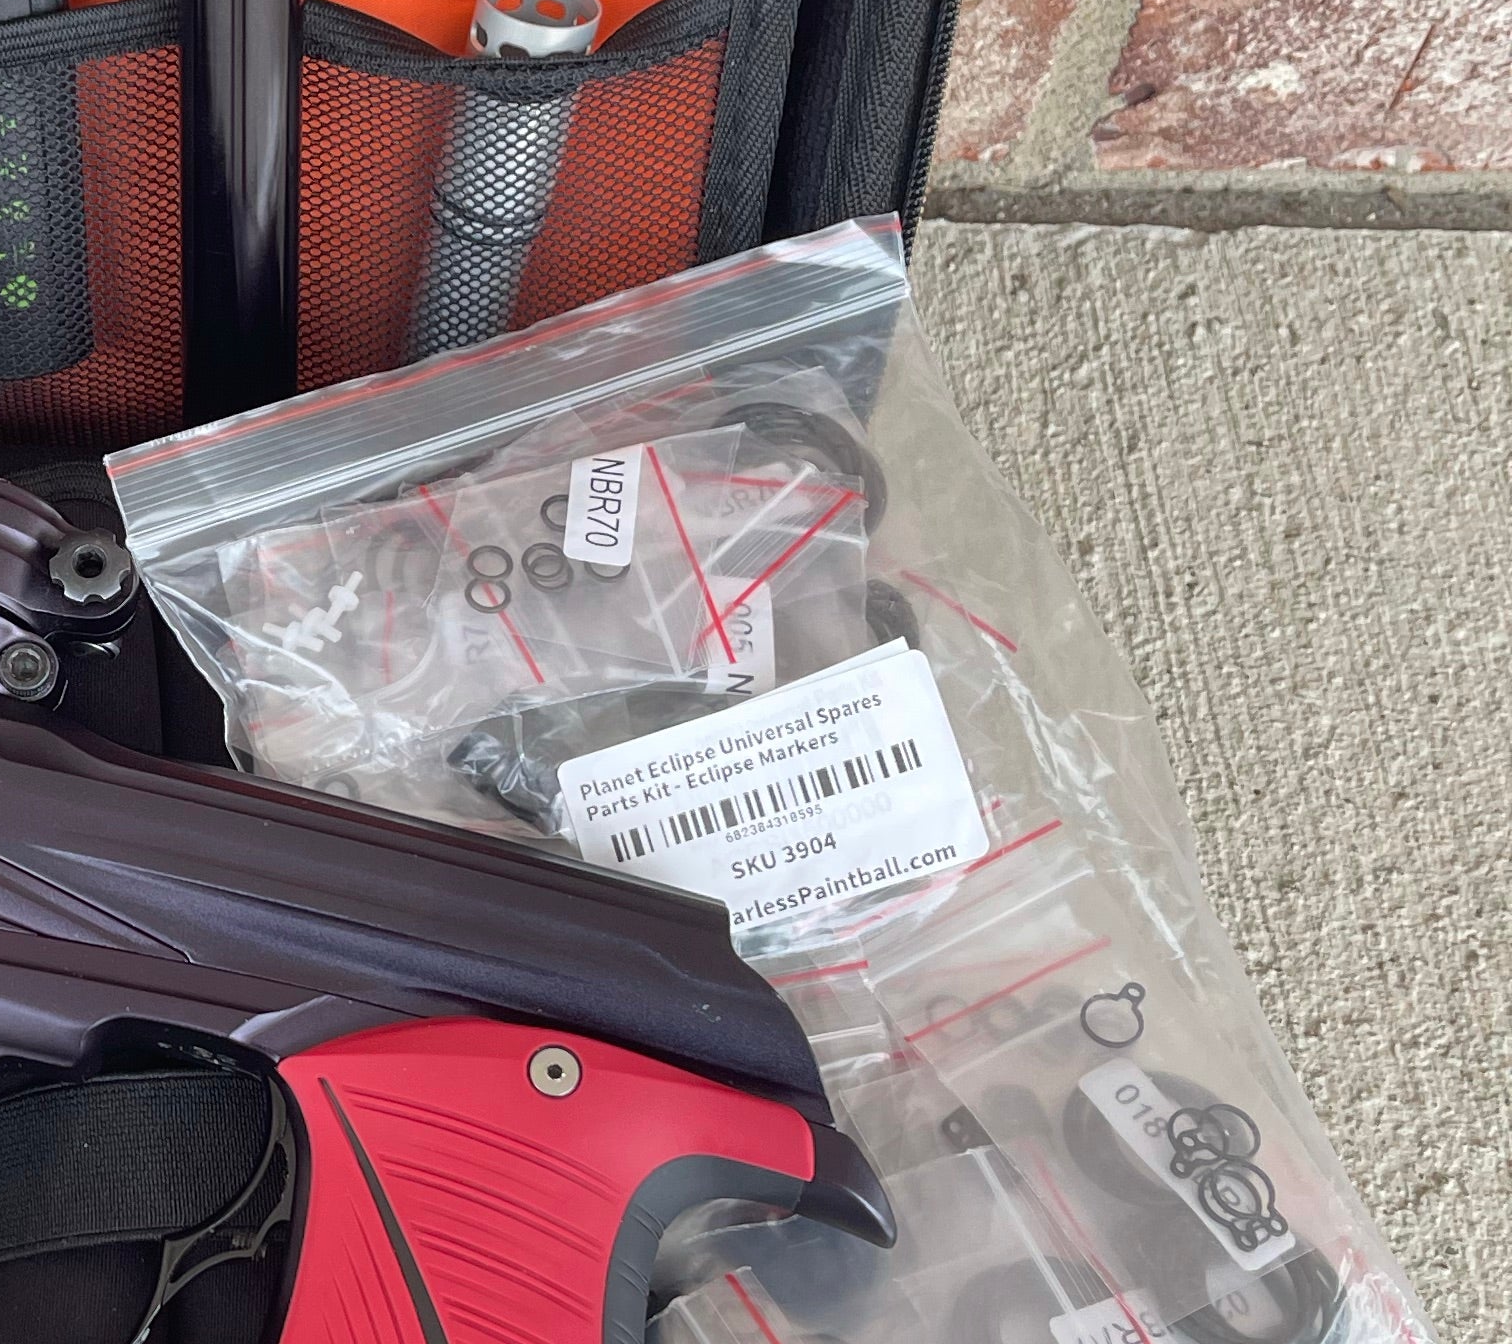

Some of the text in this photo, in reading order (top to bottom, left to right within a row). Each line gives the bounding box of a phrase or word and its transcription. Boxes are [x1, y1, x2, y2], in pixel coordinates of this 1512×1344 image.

[584, 457, 625, 548] NBR70
[579, 693, 882, 801] Planet Eclipse Universal Spares
[586, 793, 640, 822] Parts
[642, 780, 672, 804] Kit
[687, 756, 755, 789] Eclipse
[759, 730, 839, 766] Markers
[731, 831, 838, 880] SKU 3904
